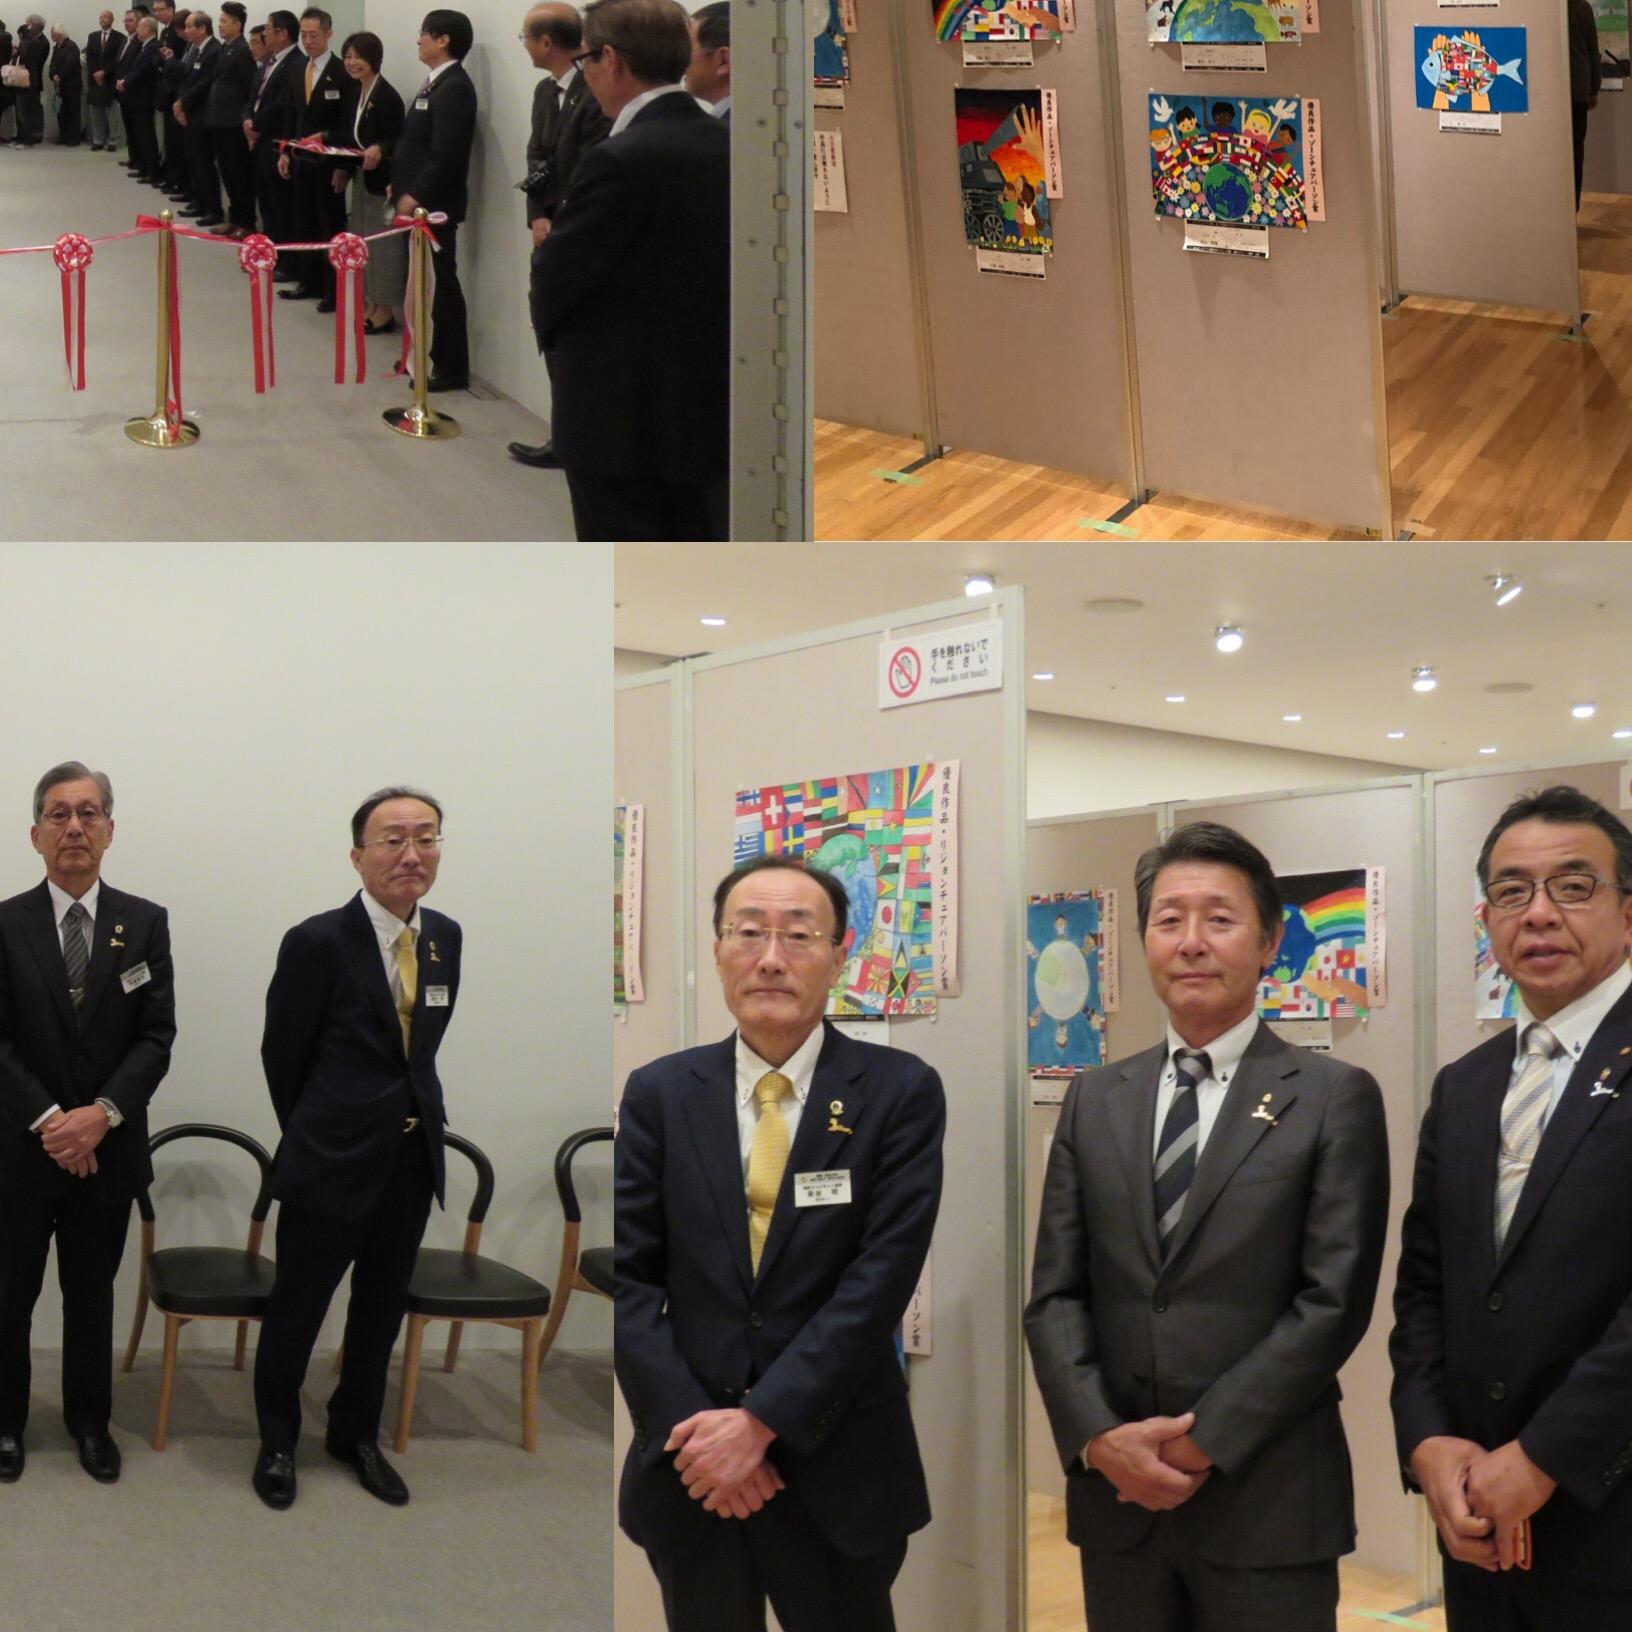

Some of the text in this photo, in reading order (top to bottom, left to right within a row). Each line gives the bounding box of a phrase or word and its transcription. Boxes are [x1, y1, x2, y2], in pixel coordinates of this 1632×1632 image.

[930, 638, 989, 662] 手を触れないで
[931, 653, 989, 673] ください
